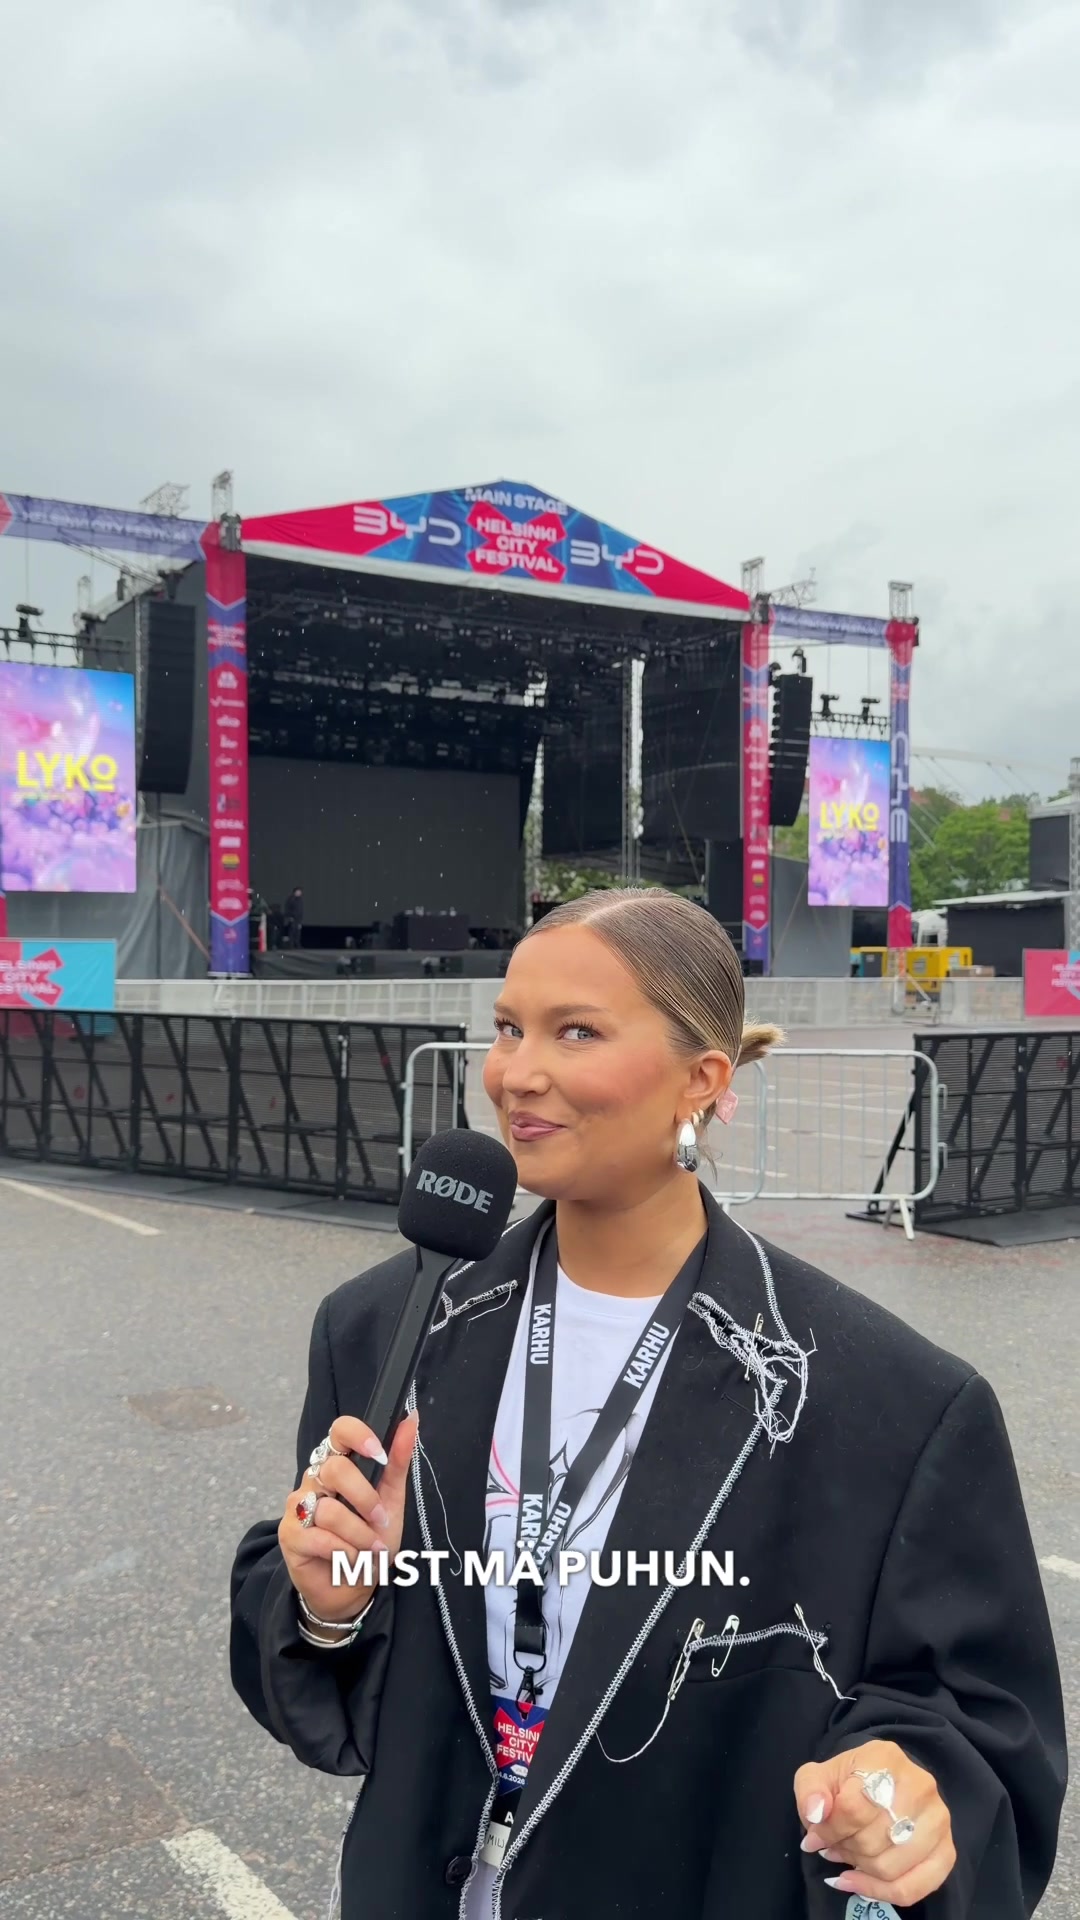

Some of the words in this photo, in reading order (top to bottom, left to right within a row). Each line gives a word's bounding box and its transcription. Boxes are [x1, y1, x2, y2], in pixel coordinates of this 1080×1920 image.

[465, 487, 514, 508] MAIN
[514, 493, 568, 517] STAGE
[353, 506, 462, 547] BYD
[476, 517, 557, 543] HELSINKI
[496, 535, 539, 554] CITY
[475, 548, 559, 574] FESTIVAL
[570, 539, 665, 576] BYD
[16, 750, 118, 791] LYKO
[890, 731, 910, 843] BYD
[819, 802, 880, 831] LYKO
[416, 1169, 494, 1214] RØDE
[530, 1303, 552, 1365] KARHU
[623, 1321, 670, 1389] KARHU
[509, 1736, 535, 1753] CITY
